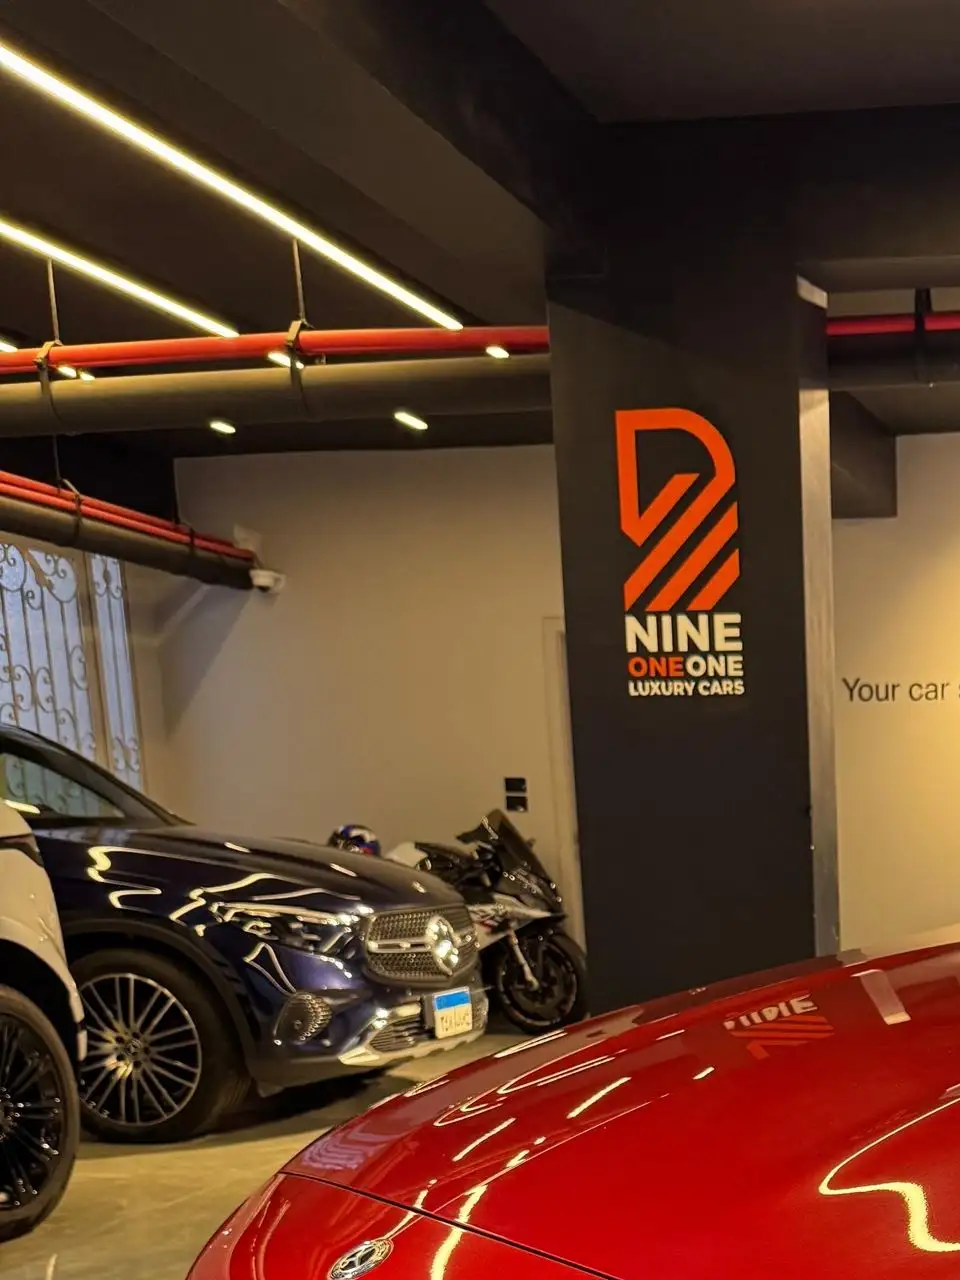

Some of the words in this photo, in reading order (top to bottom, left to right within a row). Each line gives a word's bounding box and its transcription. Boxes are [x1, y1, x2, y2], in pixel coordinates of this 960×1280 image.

[625, 613, 743, 653] NINE
[629, 681, 695, 697] LUXURY
[697, 679, 745, 695] CARS
[842, 678, 899, 702] Your
[908, 682, 949, 702] car
